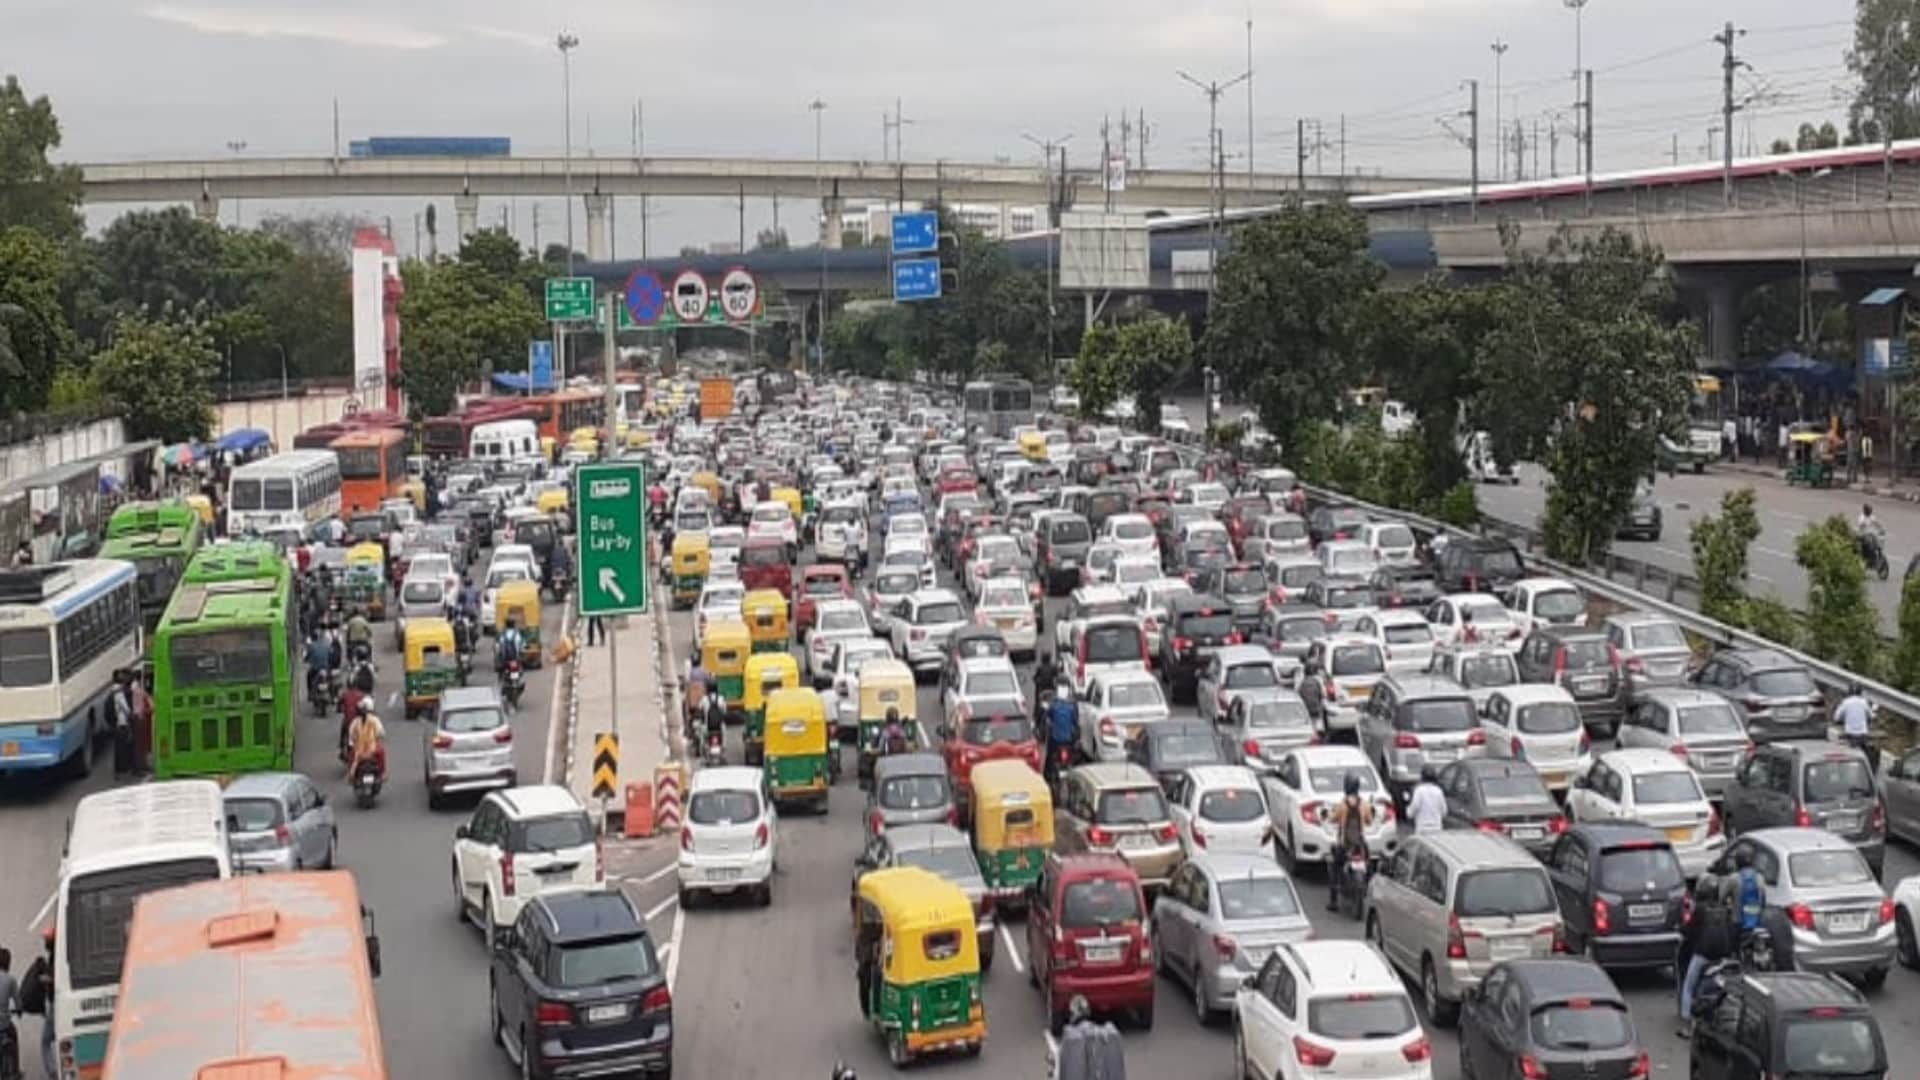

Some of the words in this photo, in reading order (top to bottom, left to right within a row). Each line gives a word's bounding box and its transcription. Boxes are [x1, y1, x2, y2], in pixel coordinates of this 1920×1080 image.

[682, 299, 700, 313] 40
[729, 296, 748, 311] 60
[590, 515, 615, 531] Bus
[590, 533, 632, 552] Lay-by
